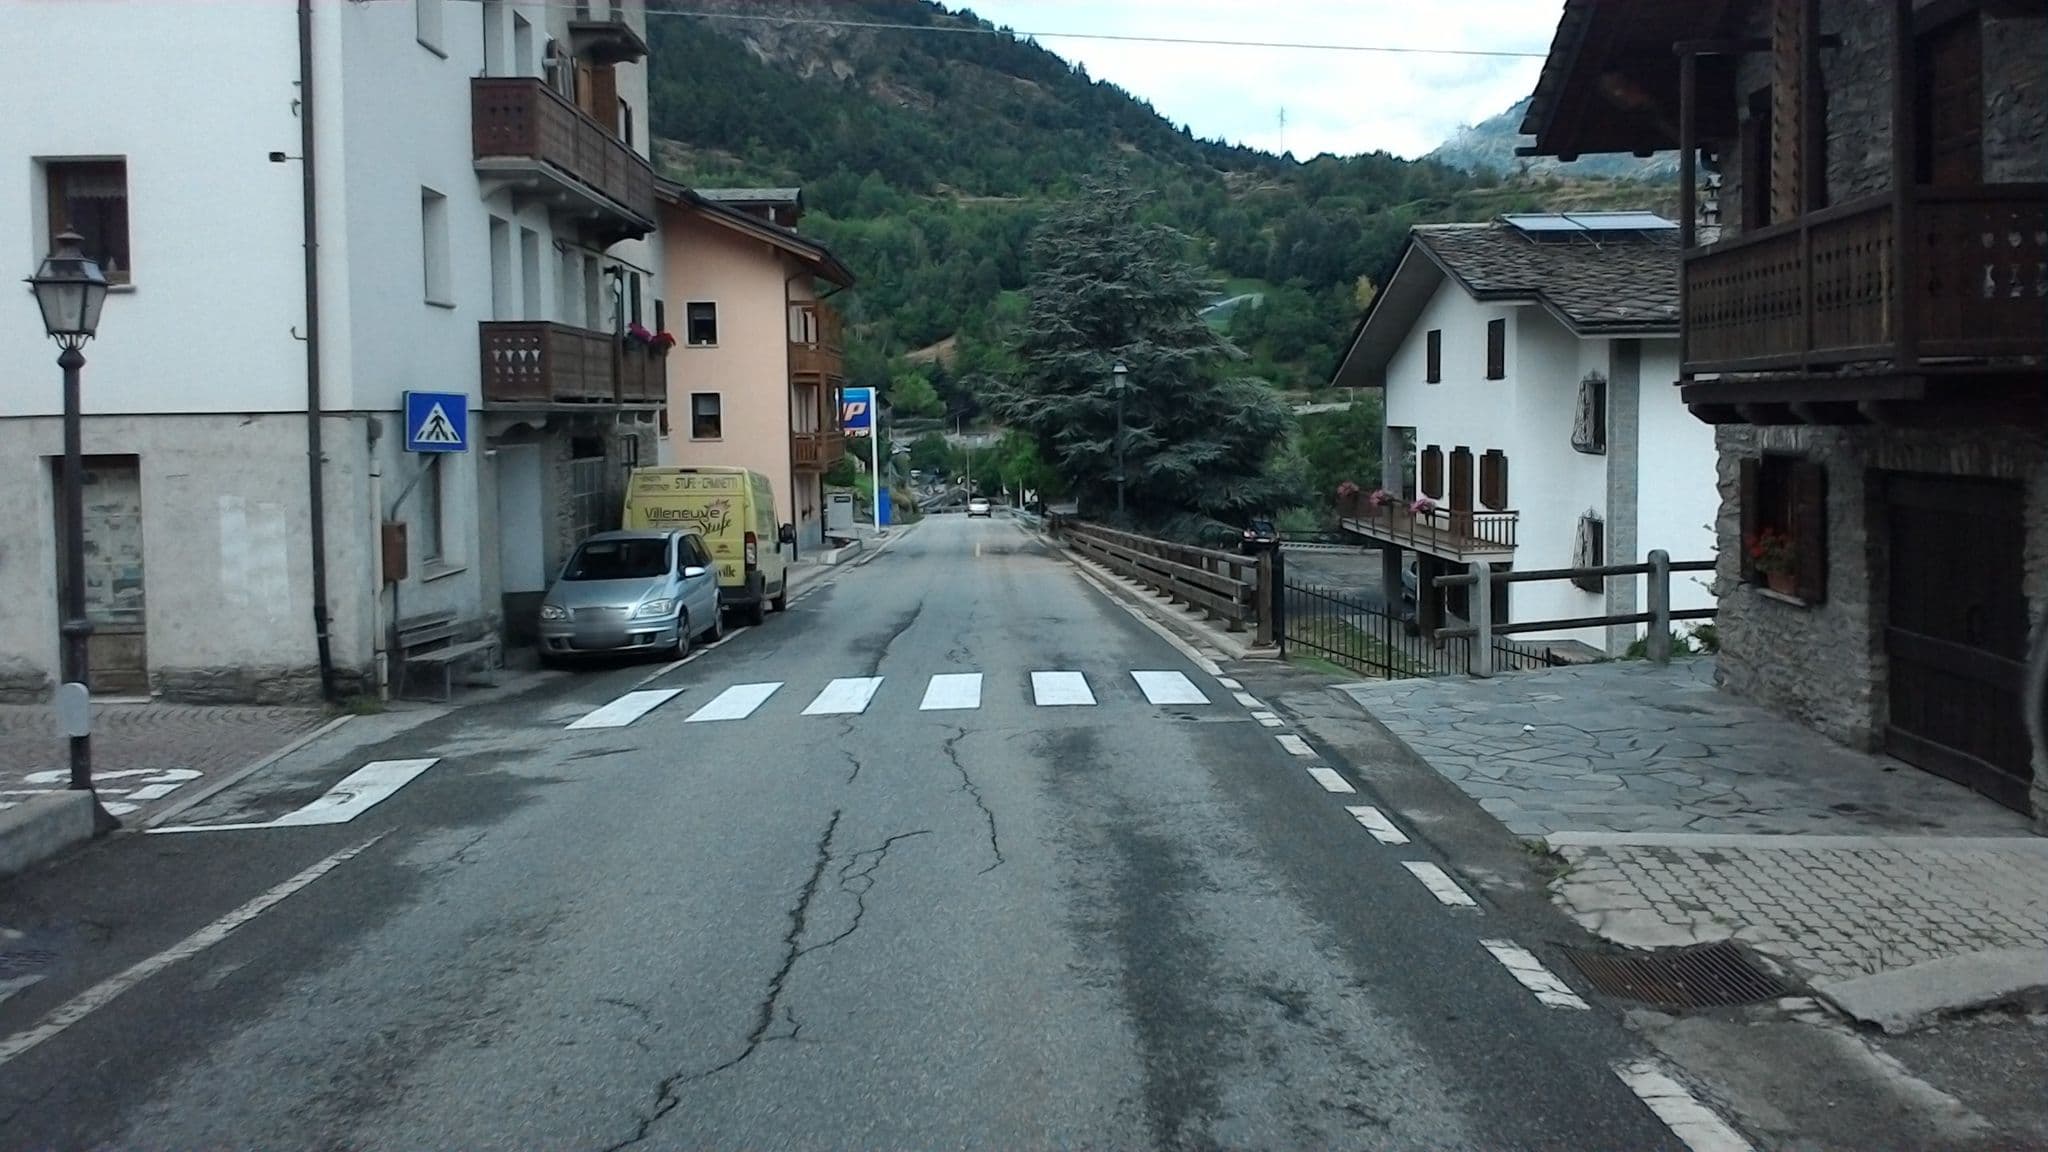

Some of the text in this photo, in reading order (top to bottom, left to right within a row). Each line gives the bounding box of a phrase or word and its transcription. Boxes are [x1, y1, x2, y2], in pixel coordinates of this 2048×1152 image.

[675, 477, 696, 489] STUFE
[645, 506, 720, 519] Villeneuve
[697, 511, 732, 537] Stufe
